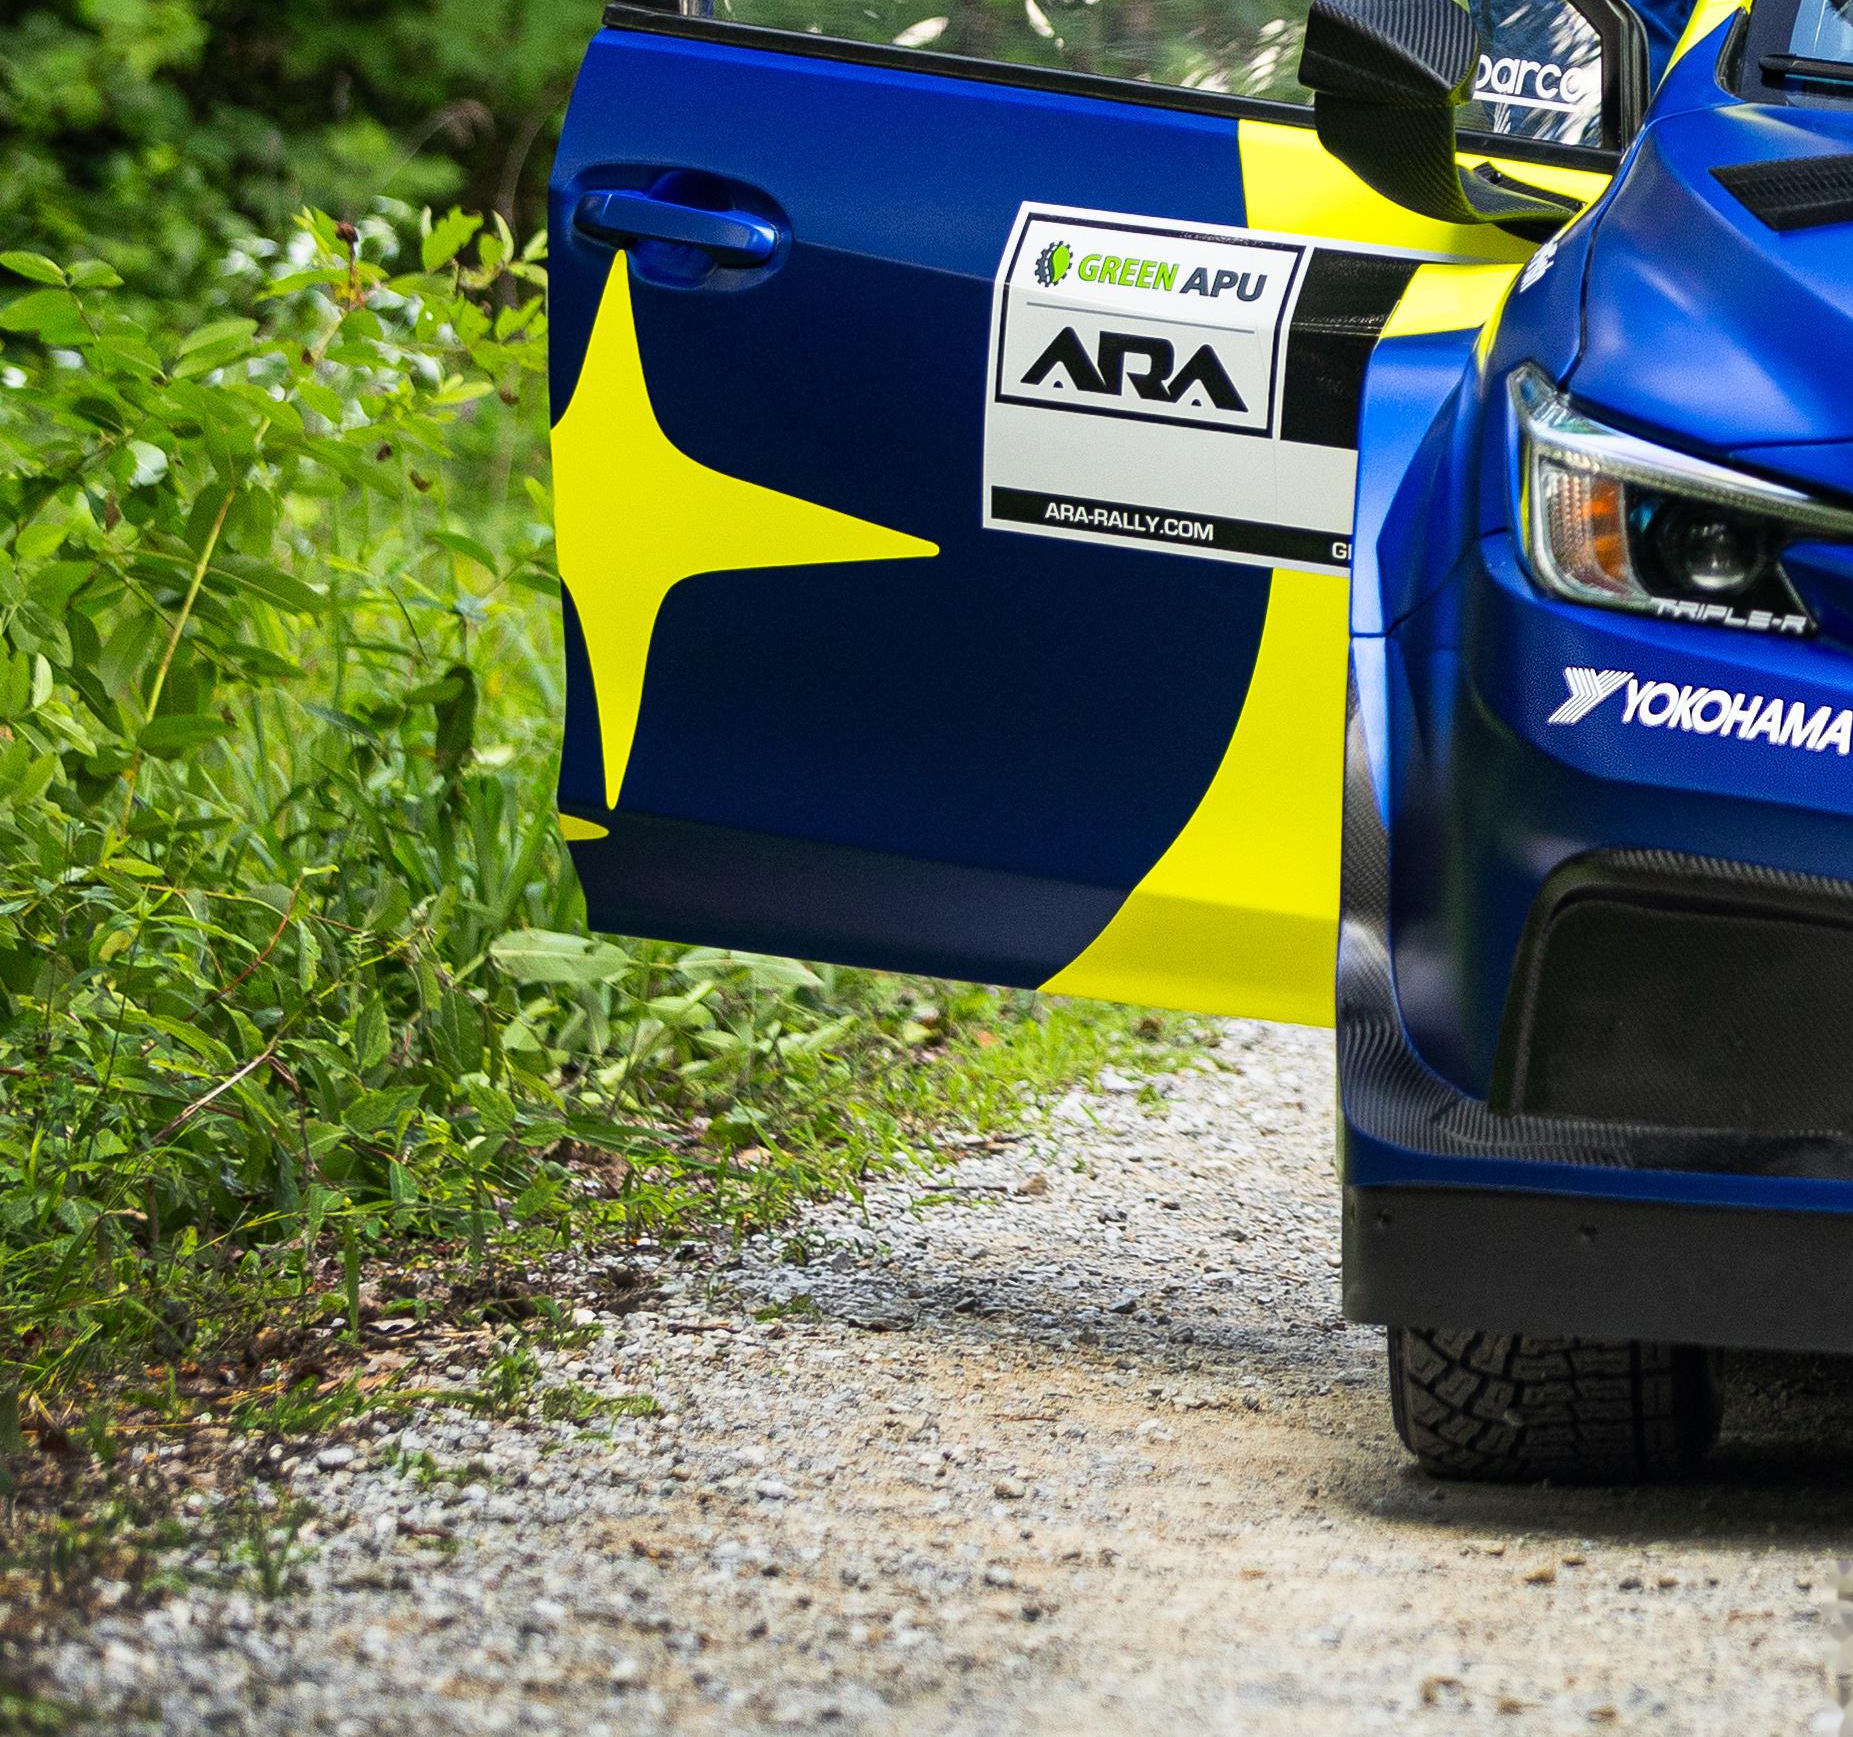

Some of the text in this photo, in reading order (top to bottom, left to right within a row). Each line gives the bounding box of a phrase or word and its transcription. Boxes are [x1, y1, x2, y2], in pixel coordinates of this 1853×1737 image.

[1079, 252, 1268, 303] GREEN APU
[1020, 325, 1250, 413] ARA
[1043, 501, 1215, 543] ARA-RALLY.COM
[1649, 596, 1808, 635] TRIPLE-R
[1620, 677, 1853, 757] YOKOHAMA
